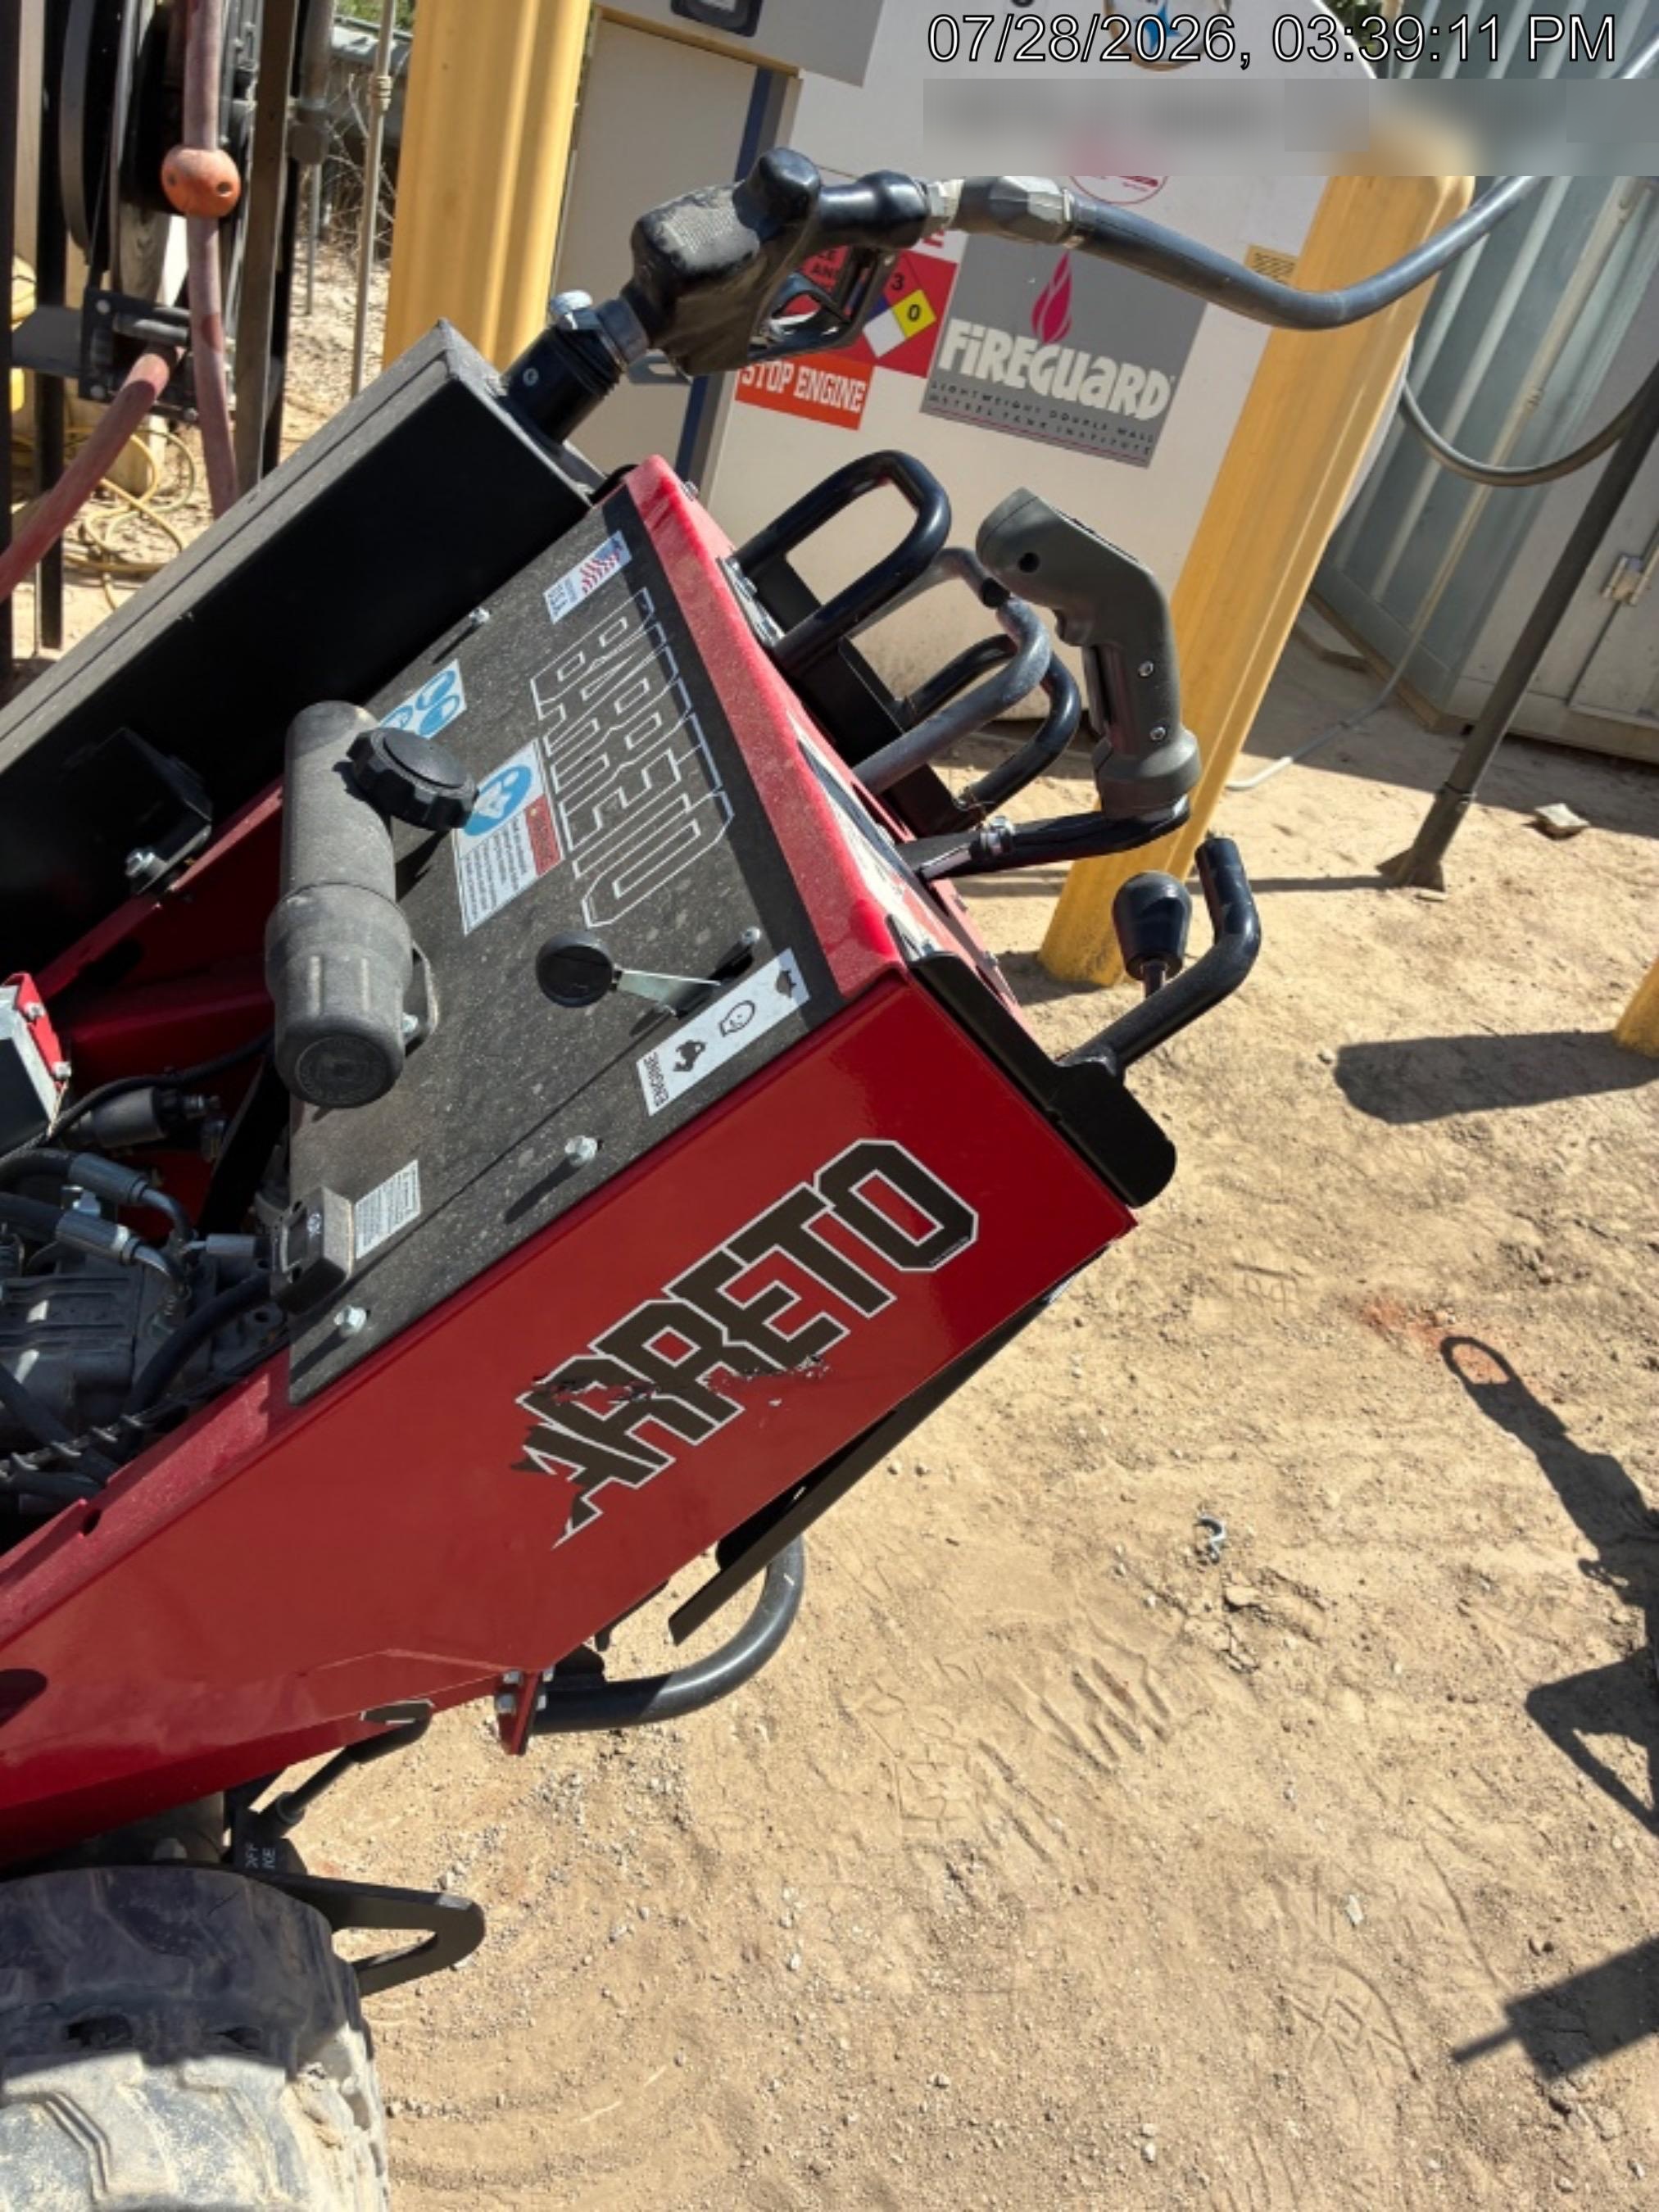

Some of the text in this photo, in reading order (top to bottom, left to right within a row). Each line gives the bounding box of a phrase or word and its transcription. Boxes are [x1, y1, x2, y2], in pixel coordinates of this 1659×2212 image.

[891, 274, 904, 290] 3
[907, 304, 922, 321] 0
[741, 359, 868, 413] STOP ENGINE
[1049, 410, 1108, 431] DOUBLE
[1117, 427, 1154, 443] WALL
[530, 587, 735, 929] BARRETO
[641, 1050, 669, 1106] ENGINE
